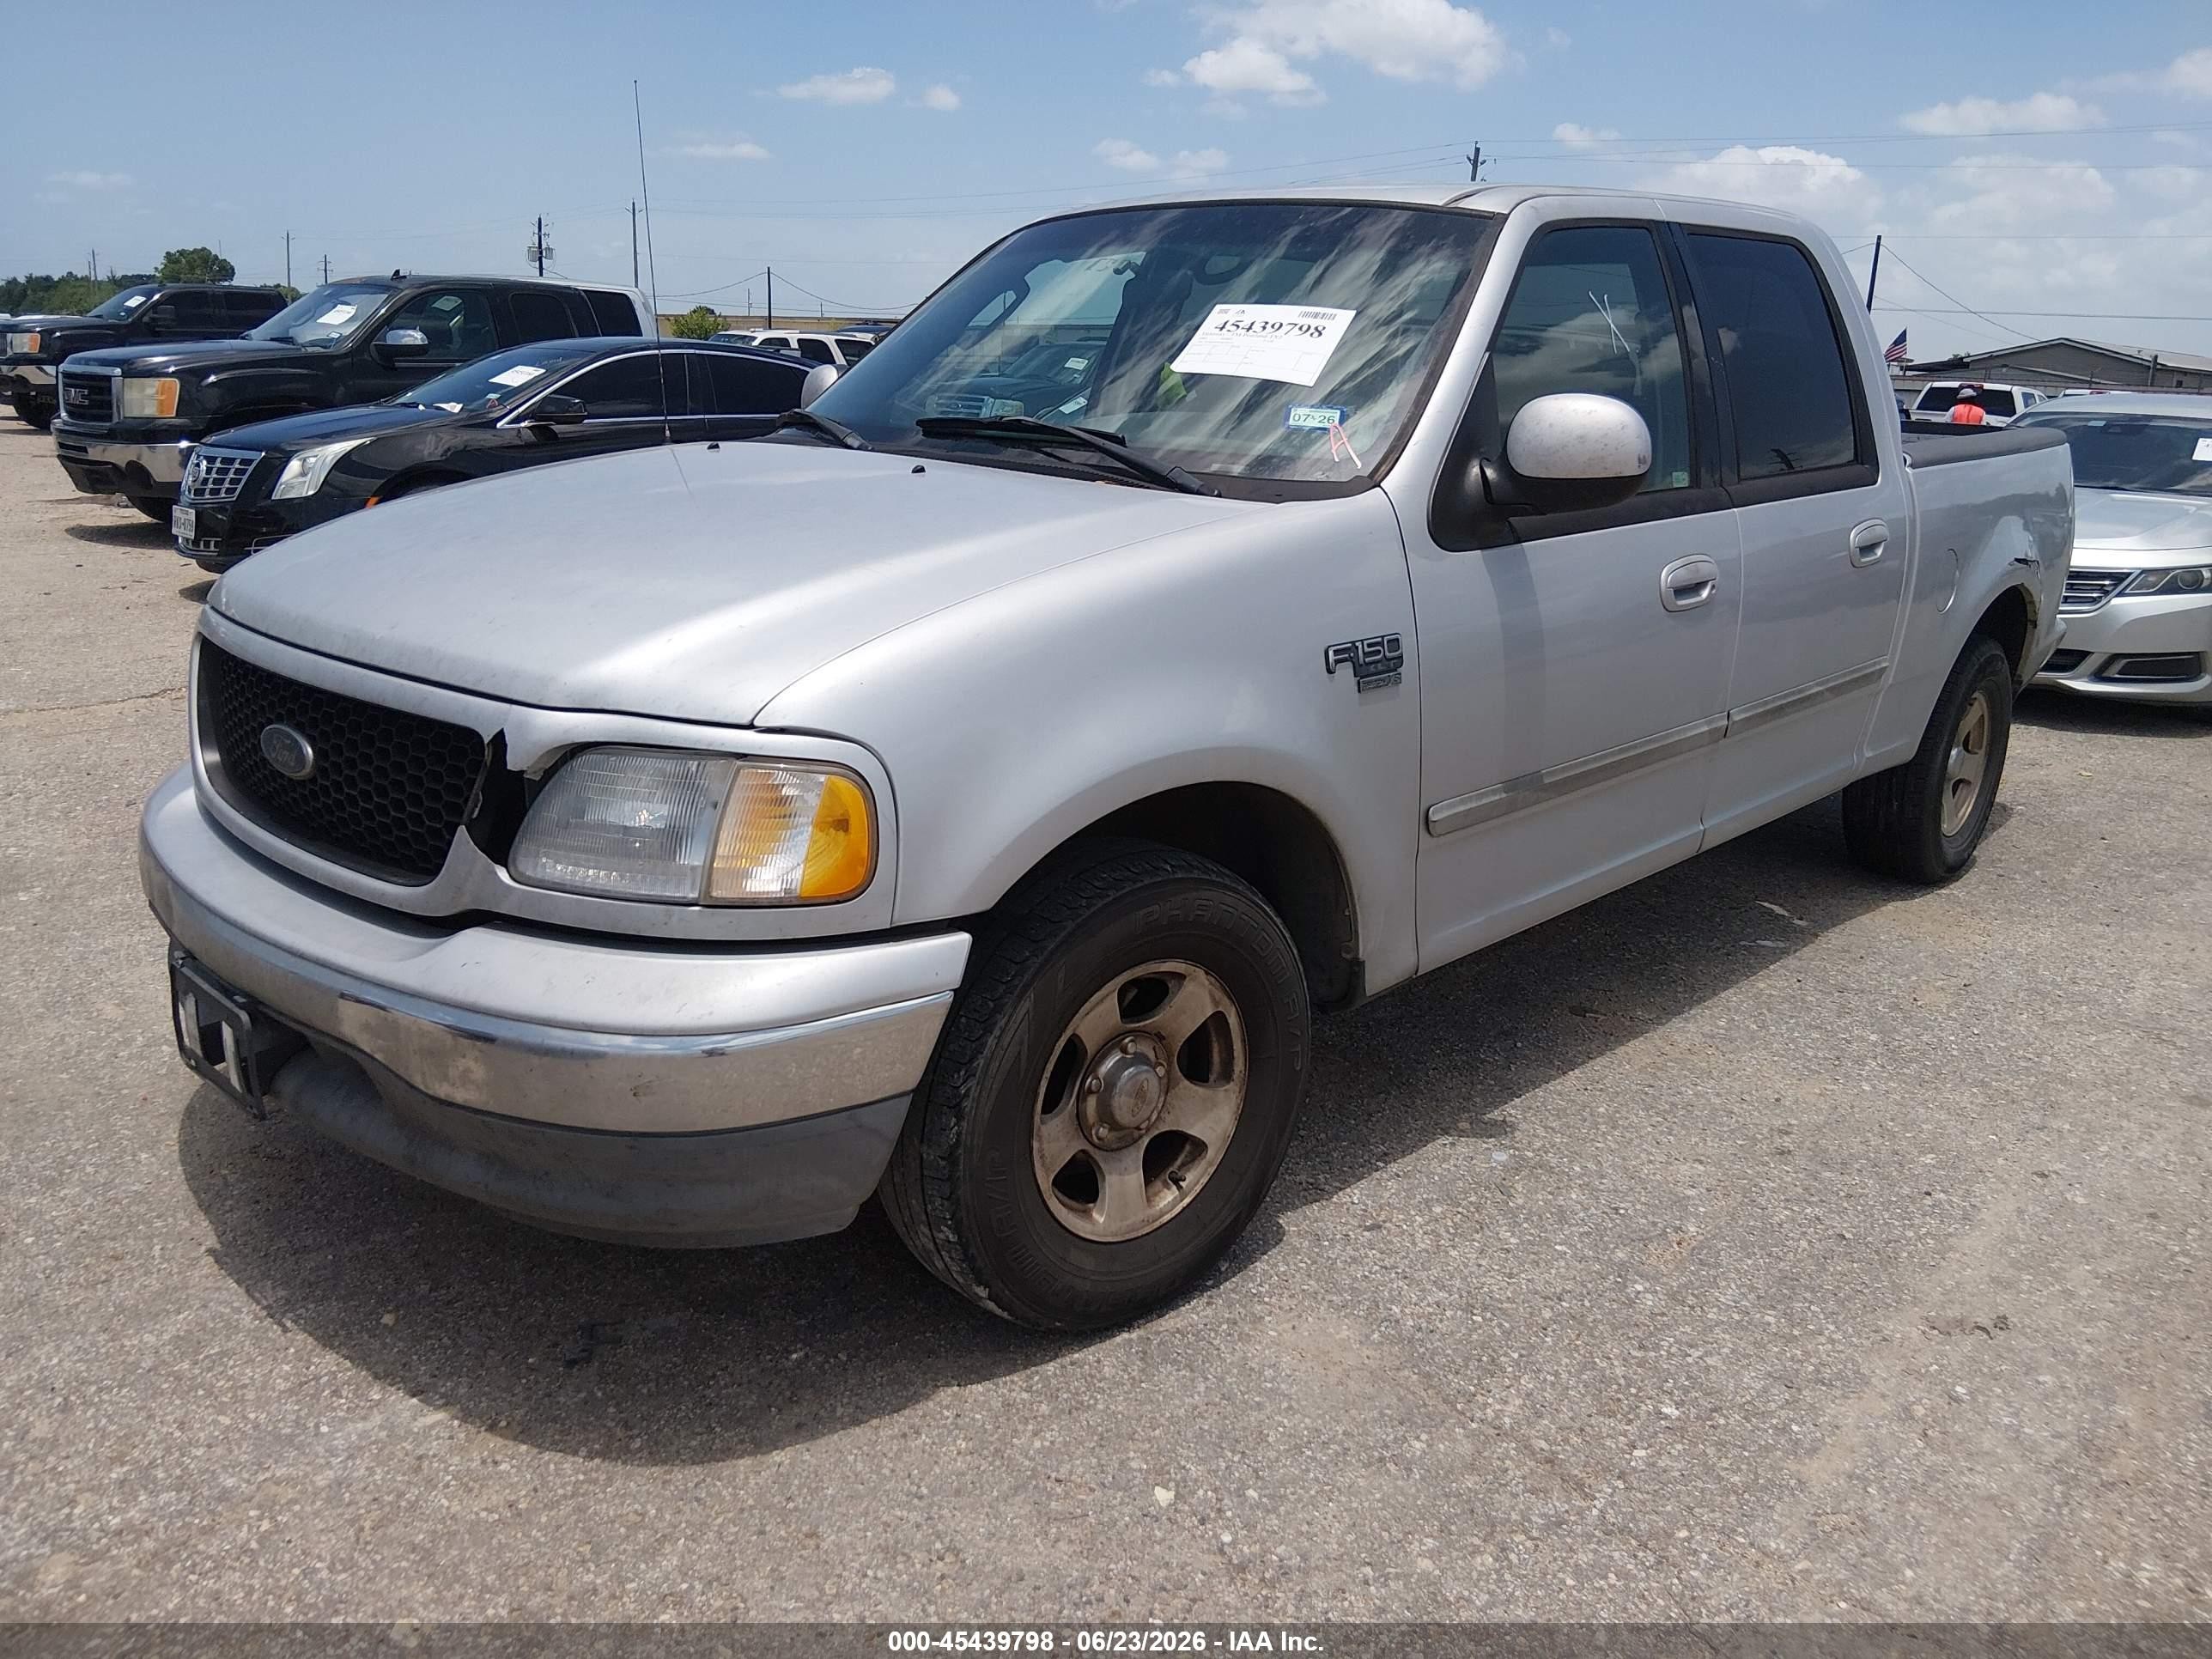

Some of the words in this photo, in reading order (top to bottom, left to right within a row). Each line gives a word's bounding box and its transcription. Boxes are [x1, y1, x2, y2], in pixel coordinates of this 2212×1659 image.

[1215, 319, 1326, 338] 45439798
[1292, 413, 1311, 422] 07
[1318, 415, 1335, 424] 26
[1133, 897, 1291, 985] PHANTOM
